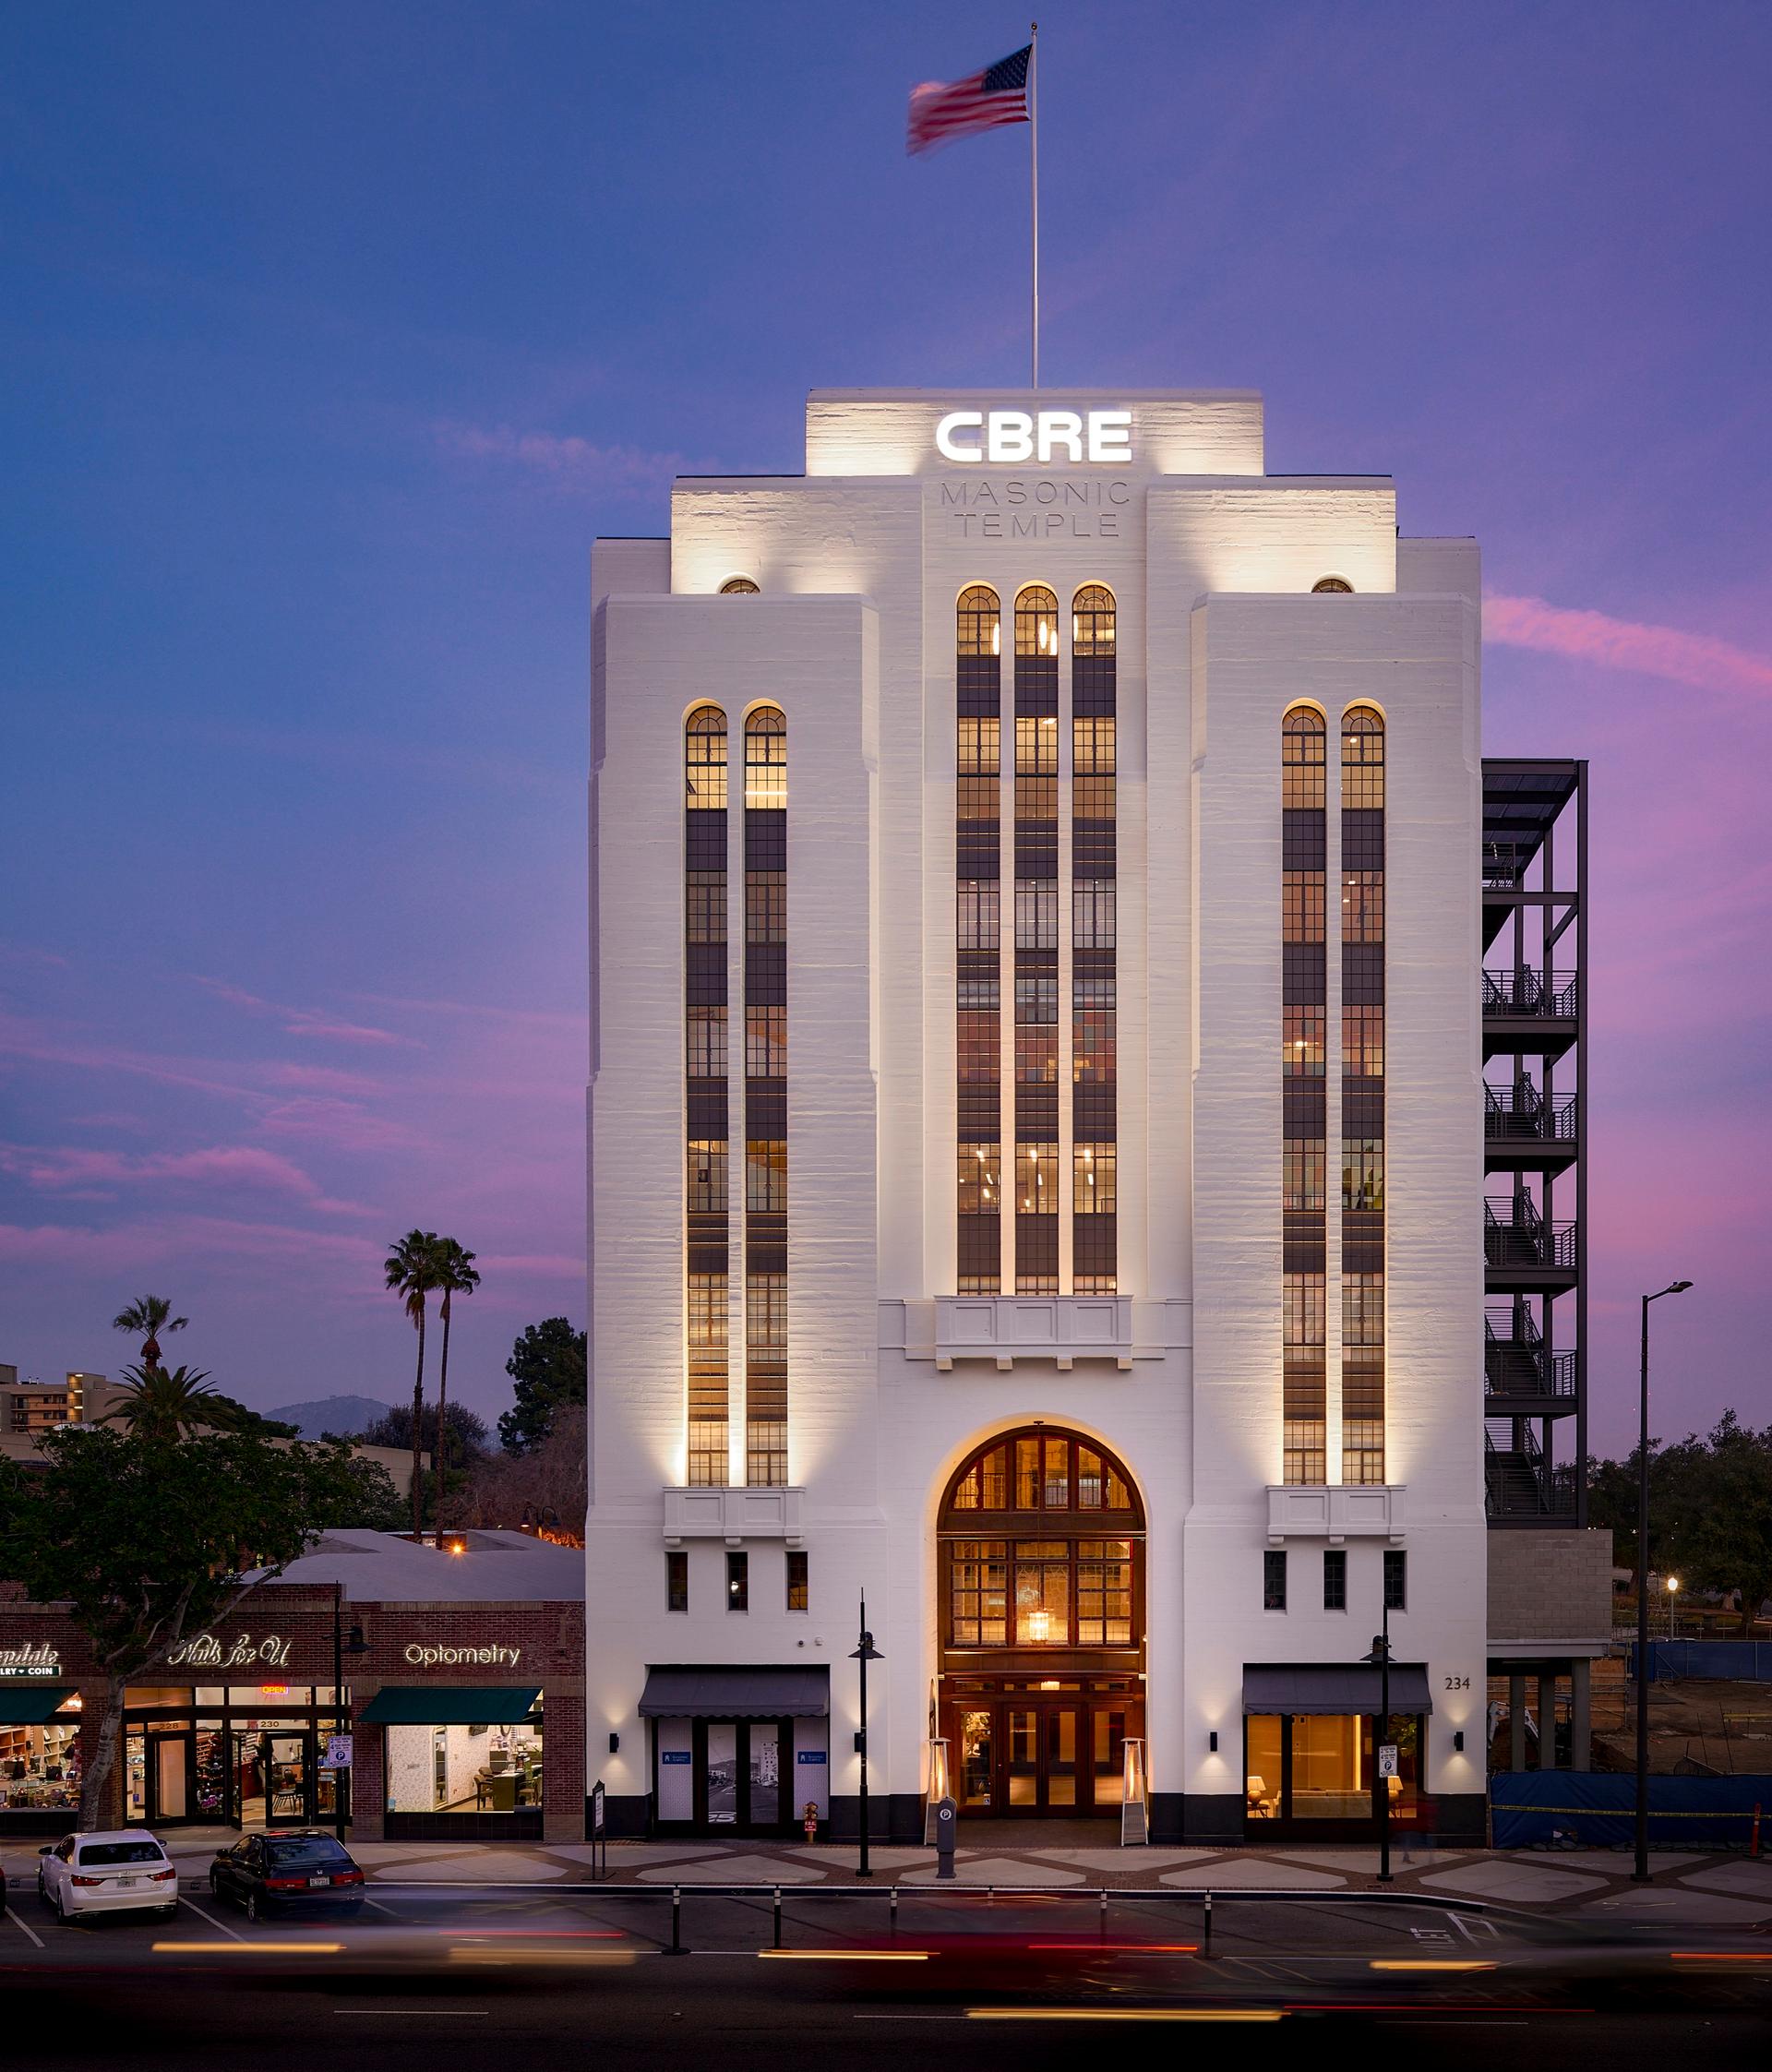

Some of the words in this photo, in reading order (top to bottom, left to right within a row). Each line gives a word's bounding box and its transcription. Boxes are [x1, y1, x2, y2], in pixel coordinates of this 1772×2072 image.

[935, 411, 1133, 463] CBRE
[940, 481, 1131, 506] MASONIC
[953, 512, 1120, 538] TEMPLE
[221, 1634, 257, 1668] for
[259, 1635, 293, 1667] U
[404, 1644, 521, 1668] Optometry
[28, 1667, 54, 1675] COIN
[1445, 1676, 1470, 1690] 234
